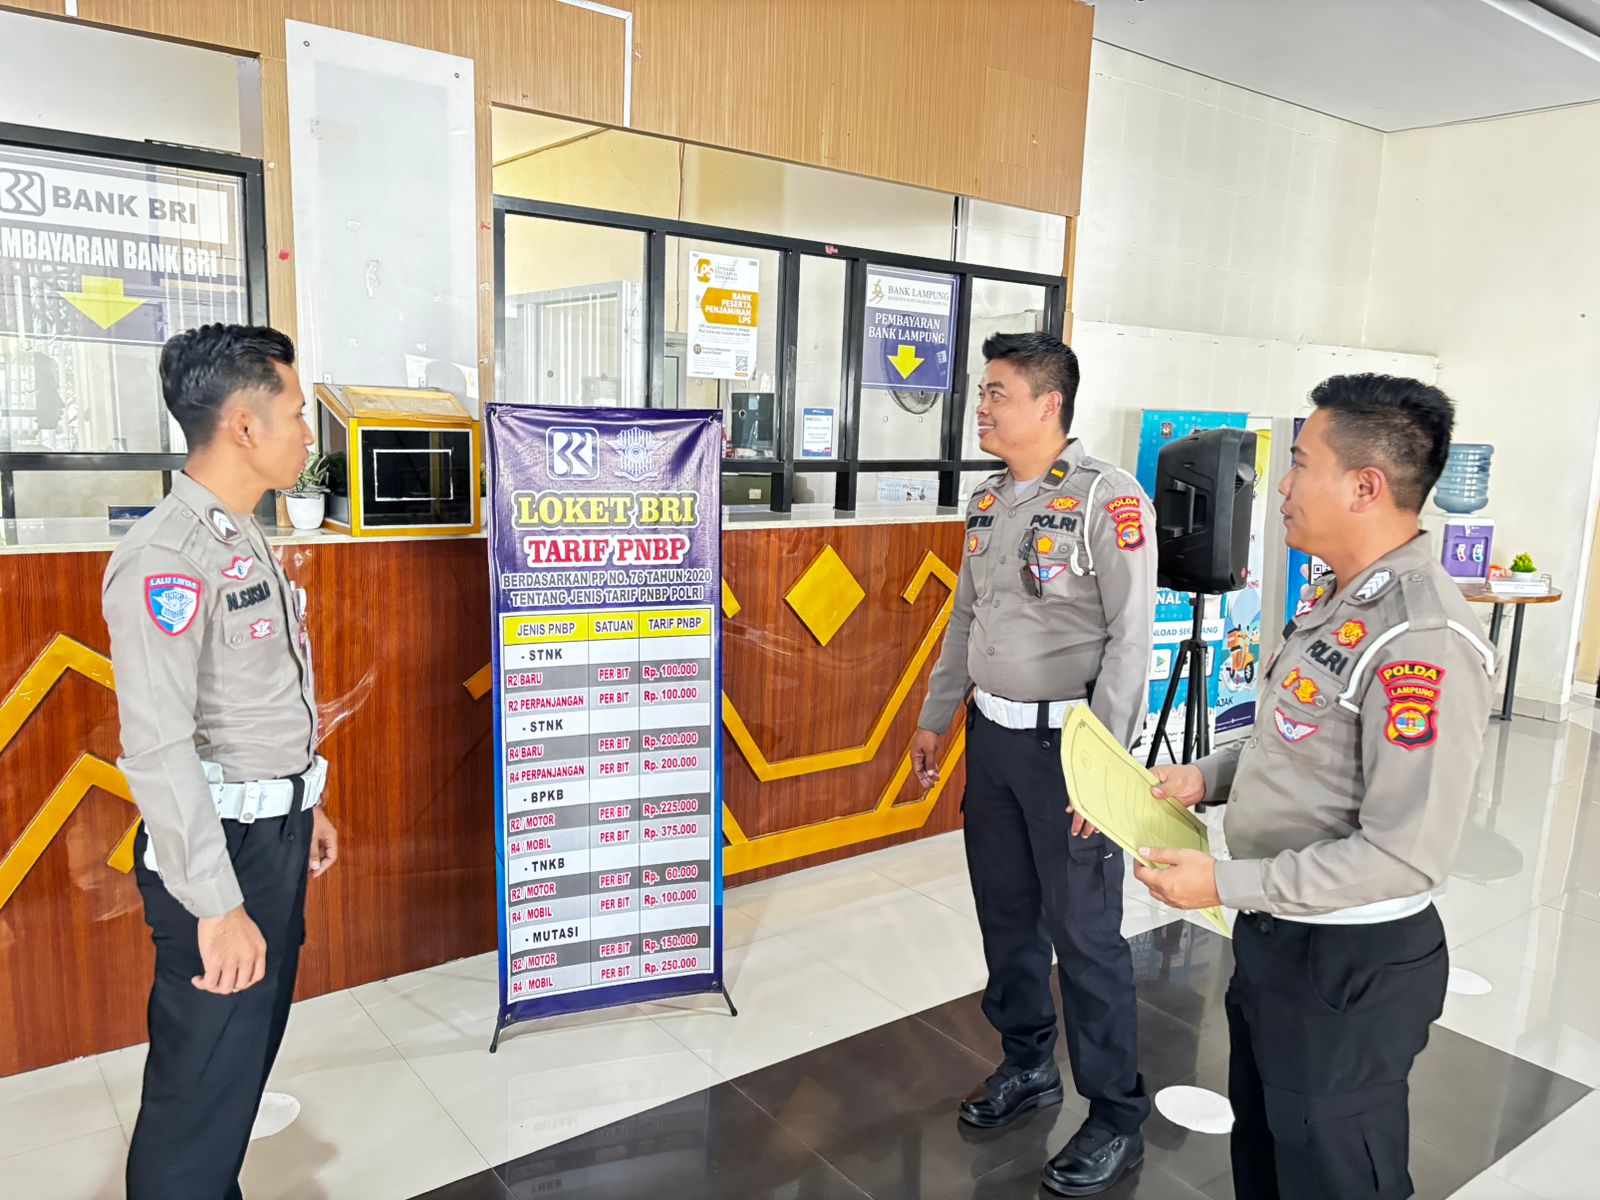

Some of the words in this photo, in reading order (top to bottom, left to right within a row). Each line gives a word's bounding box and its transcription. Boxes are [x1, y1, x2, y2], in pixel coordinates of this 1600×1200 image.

[52, 185, 139, 217] BANK
[148, 197, 197, 224] BRI
[0, 226, 118, 268] MBAYARAN
[123, 240, 181, 274] BANK
[182, 247, 217, 277] BRI
[732, 292, 752, 302] BANK
[888, 286, 911, 297] BANK
[912, 288, 949, 300] LAMPUNG
[705, 305, 752, 316] PENJAMINAN
[722, 299, 752, 310] PESERTA
[738, 316, 752, 324] LPS
[875, 312, 940, 330] PEMBAYARAN
[868, 326, 896, 340] BANK
[898, 328, 945, 344] LAMPUNG
[517, 496, 631, 524] LOKET
[639, 496, 694, 523] BRI
[1108, 498, 1138, 511] POLDA
[1030, 514, 1077, 532] POLRI
[528, 538, 610, 563] TARIF
[616, 538, 686, 562] PNBP
[150, 578, 172, 586] LALU
[503, 572, 588, 588] BERDASARKAN
[591, 572, 606, 586] PP
[609, 572, 627, 585] NO.
[631, 571, 644, 584] 76
[646, 570, 684, 584] TAHUN
[686, 569, 712, 582] 2020
[512, 592, 566, 606] TENTANG
[568, 590, 602, 604] JENIS
[606, 589, 638, 602] TARIF
[640, 588, 669, 601] PNBP
[671, 586, 704, 600] POLRI
[1155, 594, 1182, 605] NAL
[516, 624, 546, 637] JENIS
[548, 622, 575, 635] PNBP
[595, 620, 634, 633] SATUAN
[648, 618, 674, 630] TARIF
[676, 617, 701, 628] PNBP
[1152, 628, 1178, 638] NLOAD
[1178, 626, 1218, 636] SEKANG
[529, 648, 563, 662] STNK
[1305, 639, 1348, 676] POLRI
[599, 669, 614, 680] PER
[616, 668, 630, 678] BIT
[644, 666, 658, 679] Rp.
[662, 664, 697, 676] 100.000
[1382, 664, 1438, 681] POLDA
[507, 676, 519, 686] R2
[520, 673, 542, 686] BARU
[600, 693, 614, 704] PER
[616, 692, 630, 702] BIT
[644, 690, 658, 703] Rp.
[662, 688, 696, 699] 100.000
[1391, 686, 1435, 698] LAMPUNG
[508, 700, 518, 712] R2
[520, 696, 584, 710] PERPANJANGAN
[1216, 696, 1234, 708] AJAK
[530, 719, 564, 732] STNK
[600, 738, 614, 750] PER
[616, 738, 630, 748] BIT
[644, 736, 658, 749] Rp.
[661, 733, 697, 746] 200.000
[509, 748, 519, 760] R4
[521, 746, 542, 758] BARU
[600, 763, 614, 774] PER
[616, 762, 630, 772] BIT
[644, 760, 658, 772] Rp.
[661, 756, 696, 768] 200.000
[510, 772, 520, 784] R4
[521, 766, 584, 781] PERPANJANGAN
[531, 789, 564, 804] BPKB
[600, 808, 614, 820] PER
[616, 806, 630, 817] BIT
[644, 804, 658, 816] Rp.
[661, 800, 697, 812] 225.000
[510, 820, 520, 831] R2
[526, 815, 554, 830] MOTOR
[600, 832, 614, 843] PER
[617, 830, 630, 841] BIT
[644, 828, 658, 841] Rp.
[661, 824, 696, 836] 375.000
[511, 843, 520, 854] R4
[526, 839, 551, 852] MOBIL
[532, 858, 565, 872] TNKB
[600, 876, 614, 887] PER
[618, 874, 630, 885] BIT
[644, 871, 659, 883] Rp.
[666, 866, 697, 880] 60.000
[512, 889, 520, 900] R2
[527, 884, 555, 898] MOTOR
[644, 894, 658, 907] Rp.
[662, 890, 696, 902] 100.000
[601, 901, 614, 912] PER
[618, 897, 630, 908] BIT
[512, 912, 522, 923] R4
[528, 908, 552, 920] MOBIL
[533, 926, 578, 944] MUTASI
[601, 946, 615, 956] PER
[618, 942, 630, 954] BIT
[644, 940, 659, 952] Rp.
[662, 934, 698, 947] 150.000
[514, 960, 523, 970] R2
[528, 954, 556, 967] MOTOR
[644, 962, 658, 975] Rp.
[662, 958, 696, 970] 250.000
[601, 968, 615, 979] PER
[618, 966, 630, 977] BIT
[514, 982, 522, 994] R4
[528, 978, 553, 990] MOBIL
